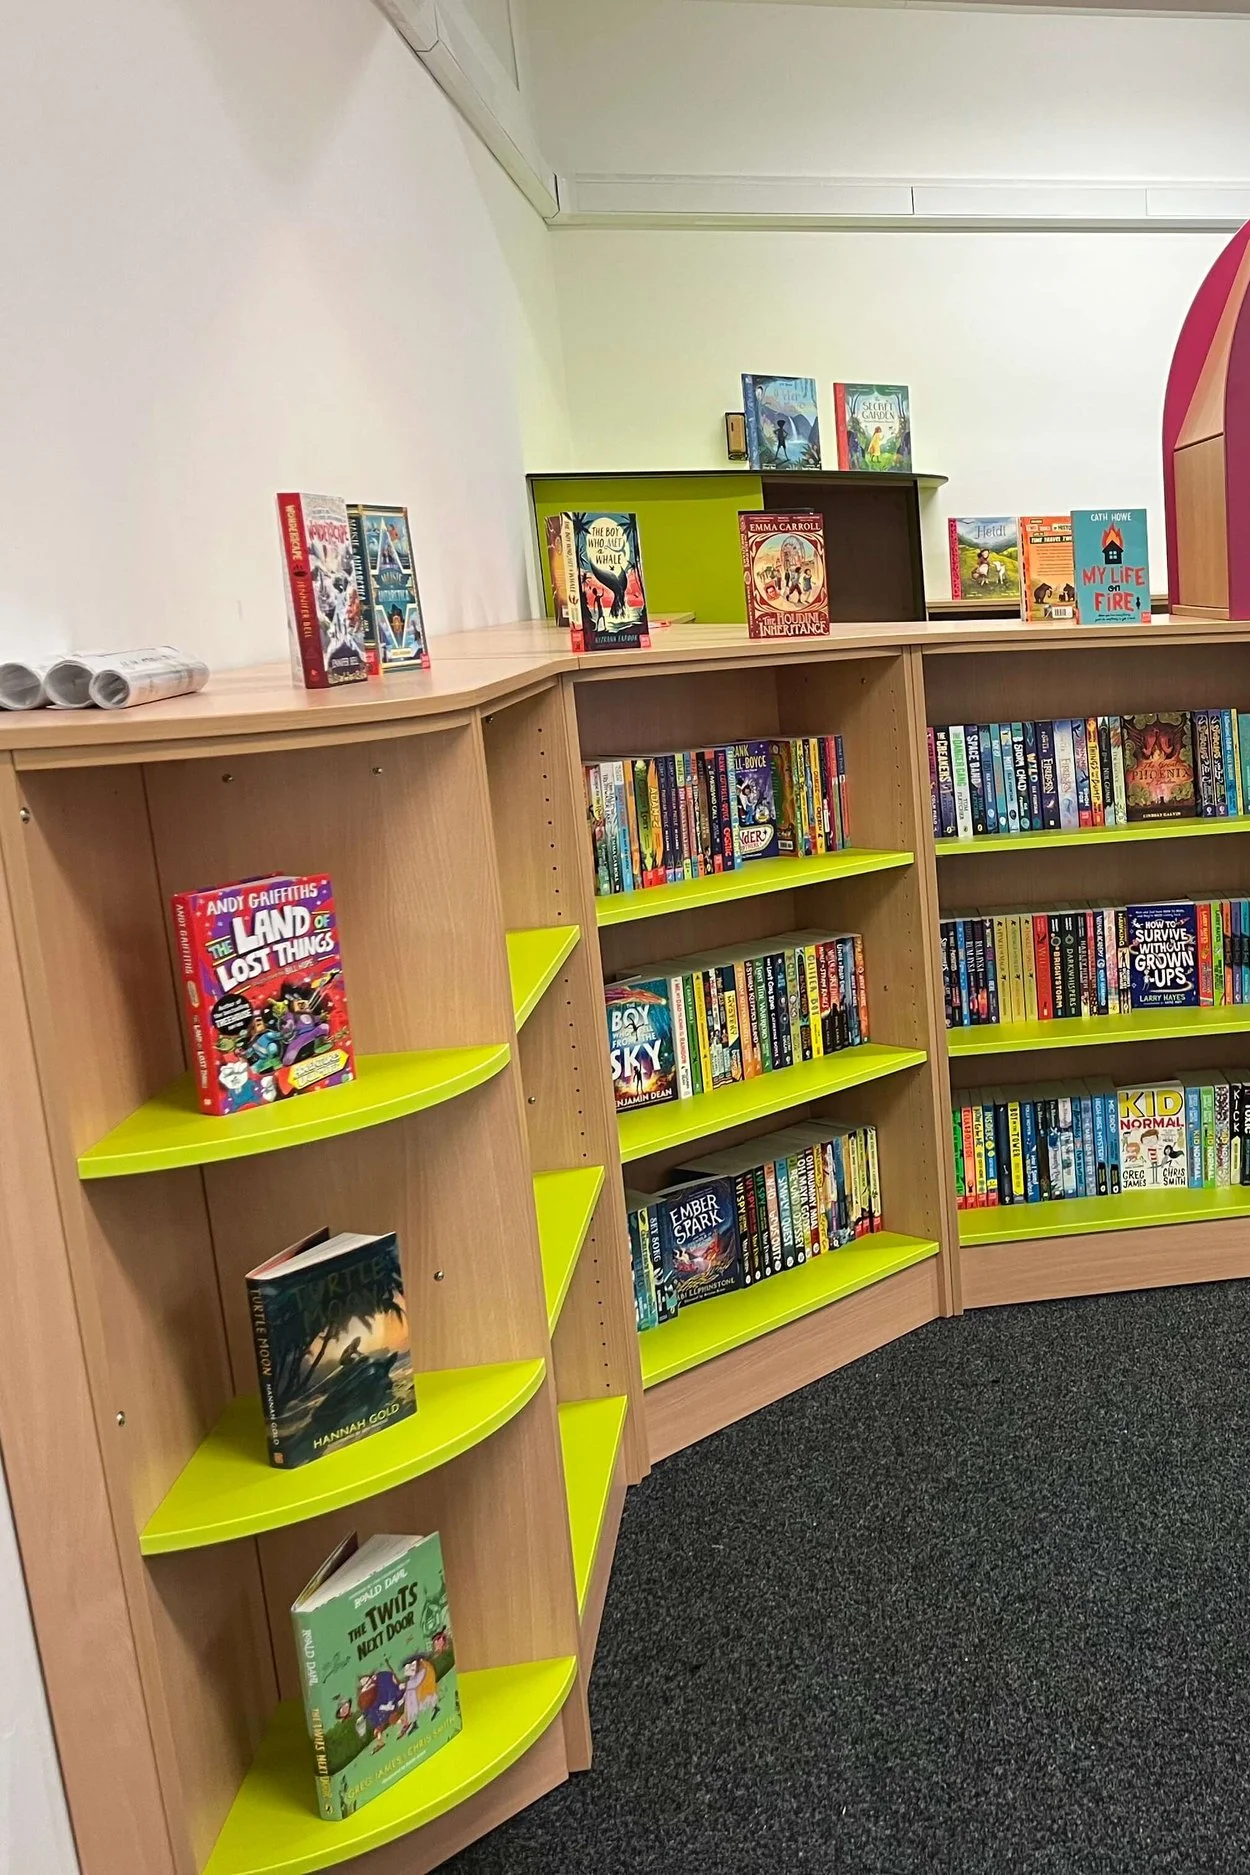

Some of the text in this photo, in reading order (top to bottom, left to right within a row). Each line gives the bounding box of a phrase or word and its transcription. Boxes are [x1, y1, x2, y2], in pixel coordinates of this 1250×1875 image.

[862, 411, 894, 420] GARDEN
[863, 401, 894, 412] SECRET
[285, 504, 303, 560] WONDERSCAPE
[592, 526, 620, 537] THE BOY
[750, 522, 822, 532] EMMA CARROLL
[1090, 512, 1132, 522] CATH HOWE
[588, 538, 604, 548] WHO
[974, 525, 1006, 540] Heidi
[596, 554, 622, 565] WHALE
[1082, 567, 1108, 586] MY
[1108, 584, 1120, 593] on
[296, 582, 312, 638] JENNIFER BELL
[776, 612, 820, 625] HOUDINI
[758, 622, 828, 638] INHERITANCE
[936, 740, 950, 783] CREAKERS
[952, 740, 966, 786] DANGER GANG
[967, 735, 981, 785] SPACE BAND
[1014, 744, 1026, 791] STORM CHILD
[1027, 753, 1038, 783] WILD
[1089, 745, 1101, 802] THINGS BUMP
[1102, 767, 1110, 781] NEIL
[1131, 768, 1190, 781] PHOENIX
[1043, 758, 1055, 794] FIREBORN
[650, 787, 660, 828] ADAM-2
[206, 883, 318, 916] ANDY GRIFFITHS
[175, 904, 185, 928] ANDY
[1145, 920, 1176, 928] HOW TO
[207, 905, 330, 960] THE LAND OF
[1136, 928, 1188, 942] SURVIVE
[1139, 941, 1186, 953] WITHOUT
[215, 932, 335, 992] LOST THINGS
[966, 941, 975, 972] RUMAYSA
[975, 940, 984, 972] RUMAYSA
[1134, 951, 1195, 972] GROWN
[746, 967, 754, 992] STORM
[1053, 952, 1062, 1008] BRIGHTSTORM
[1067, 948, 1076, 1006] DARKWHISPERS
[1149, 968, 1187, 987] -UPS
[215, 1008, 253, 1028] TREEHOUSE
[612, 1004, 649, 1032] BOY
[612, 1036, 634, 1048] FROM
[613, 1028, 628, 1039] WHO
[610, 1040, 662, 1080] SKY
[651, 1088, 672, 1100] DEAN
[1120, 1090, 1184, 1118] KID
[1095, 1098, 1103, 1130] HIGH-RISE
[1120, 1116, 1184, 1130] NORMAL
[1010, 1108, 1020, 1157] BOY TOWER
[797, 1160, 808, 1204] OH MAYA
[805, 1156, 816, 1207] OH MUMMY
[1123, 1170, 1145, 1180] GREG
[1123, 1179, 1147, 1189] JAMES
[1163, 1167, 1185, 1176] CHRIS
[1163, 1176, 1186, 1186] SMITH
[670, 1194, 720, 1228] EMBER
[735, 1184, 746, 1214] VI SPY
[746, 1195, 754, 1209] SPY
[757, 1189, 765, 1205] SPY
[778, 1177, 791, 1247] SIMPLY QUEST
[650, 1217, 661, 1262] SKY SONG
[674, 1209, 725, 1245] SPARK
[793, 1212, 804, 1249] ODYSSEY
[292, 1257, 386, 1303] TURTLE
[303, 1286, 380, 1330] MOON
[250, 1288, 274, 1377] TURTLE MOON
[266, 1383, 276, 1421] HANNAH
[313, 1403, 400, 1449] HANNAH GOLD
[354, 1568, 408, 1609] ROALD DAHL
[348, 1623, 367, 1645] THE
[357, 1610, 415, 1661] NEXT DOOR
[312, 1724, 326, 1755] TWITS
[406, 1720, 455, 1756] CHRIS SMITH
[348, 1757, 403, 1799] GREG JAMES
